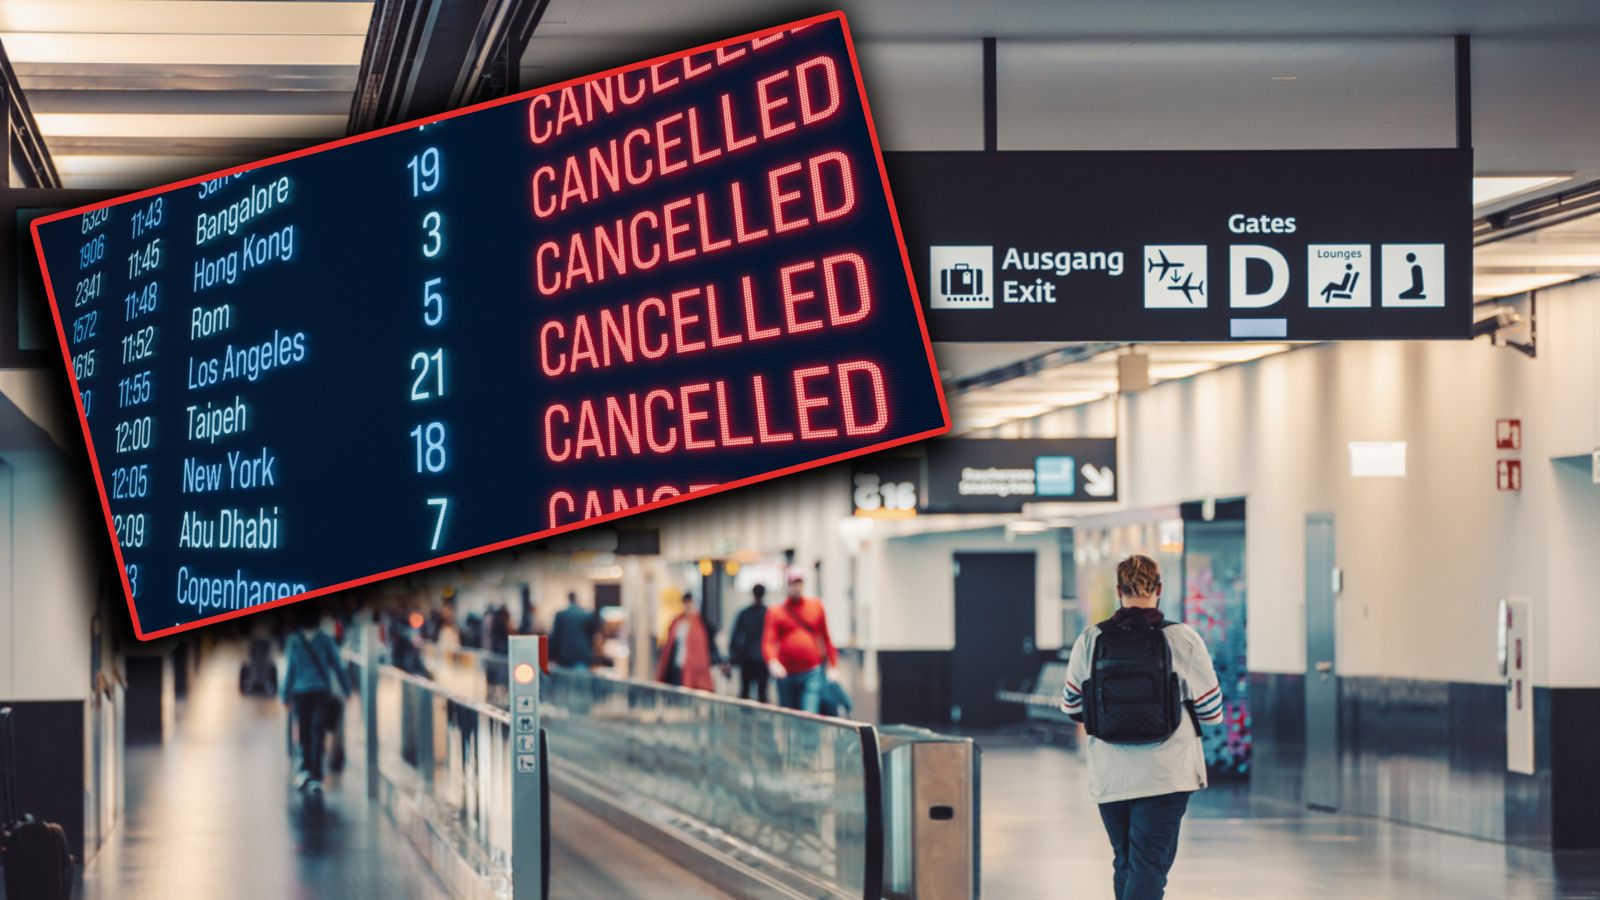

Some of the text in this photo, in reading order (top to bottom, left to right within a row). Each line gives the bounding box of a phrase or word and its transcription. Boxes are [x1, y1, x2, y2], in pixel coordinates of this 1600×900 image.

[532, 55, 840, 218] CANCELLED
[406, 146, 440, 198] 19
[130, 197, 163, 240] 11:43
[195, 176, 290, 246] Bangalore
[535, 150, 856, 296] CANCELLED
[1228, 213, 1297, 234] Gates
[80, 234, 105, 270] 1906
[422, 210, 443, 258] 3
[1317, 249, 1363, 261] Lounges
[127, 238, 161, 281] 11:45
[193, 224, 294, 293] Hong Kong
[1001, 247, 1125, 276] Ausgang
[1229, 244, 1290, 309] D
[75, 271, 101, 307] 2341
[124, 281, 158, 322] 11:48
[423, 277, 443, 327] 5
[1003, 277, 1057, 304] Exit
[72, 310, 97, 344] 1572
[190, 303, 230, 341] Rom
[539, 251, 873, 377] CANCELLED
[121, 325, 155, 365] 11:52
[188, 329, 305, 390] Los Angeles
[118, 370, 151, 408] 11:55
[410, 347, 444, 402] 21
[186, 395, 247, 444] Taipeh
[543, 360, 889, 463] CANCELLED
[114, 416, 152, 454] 12:00
[410, 421, 447, 473] 18
[111, 463, 148, 499] 12:05
[182, 446, 275, 494] New York
[112, 514, 145, 547] 2:09
[178, 506, 278, 550] Abu Dhabi
[426, 497, 449, 551] 7
